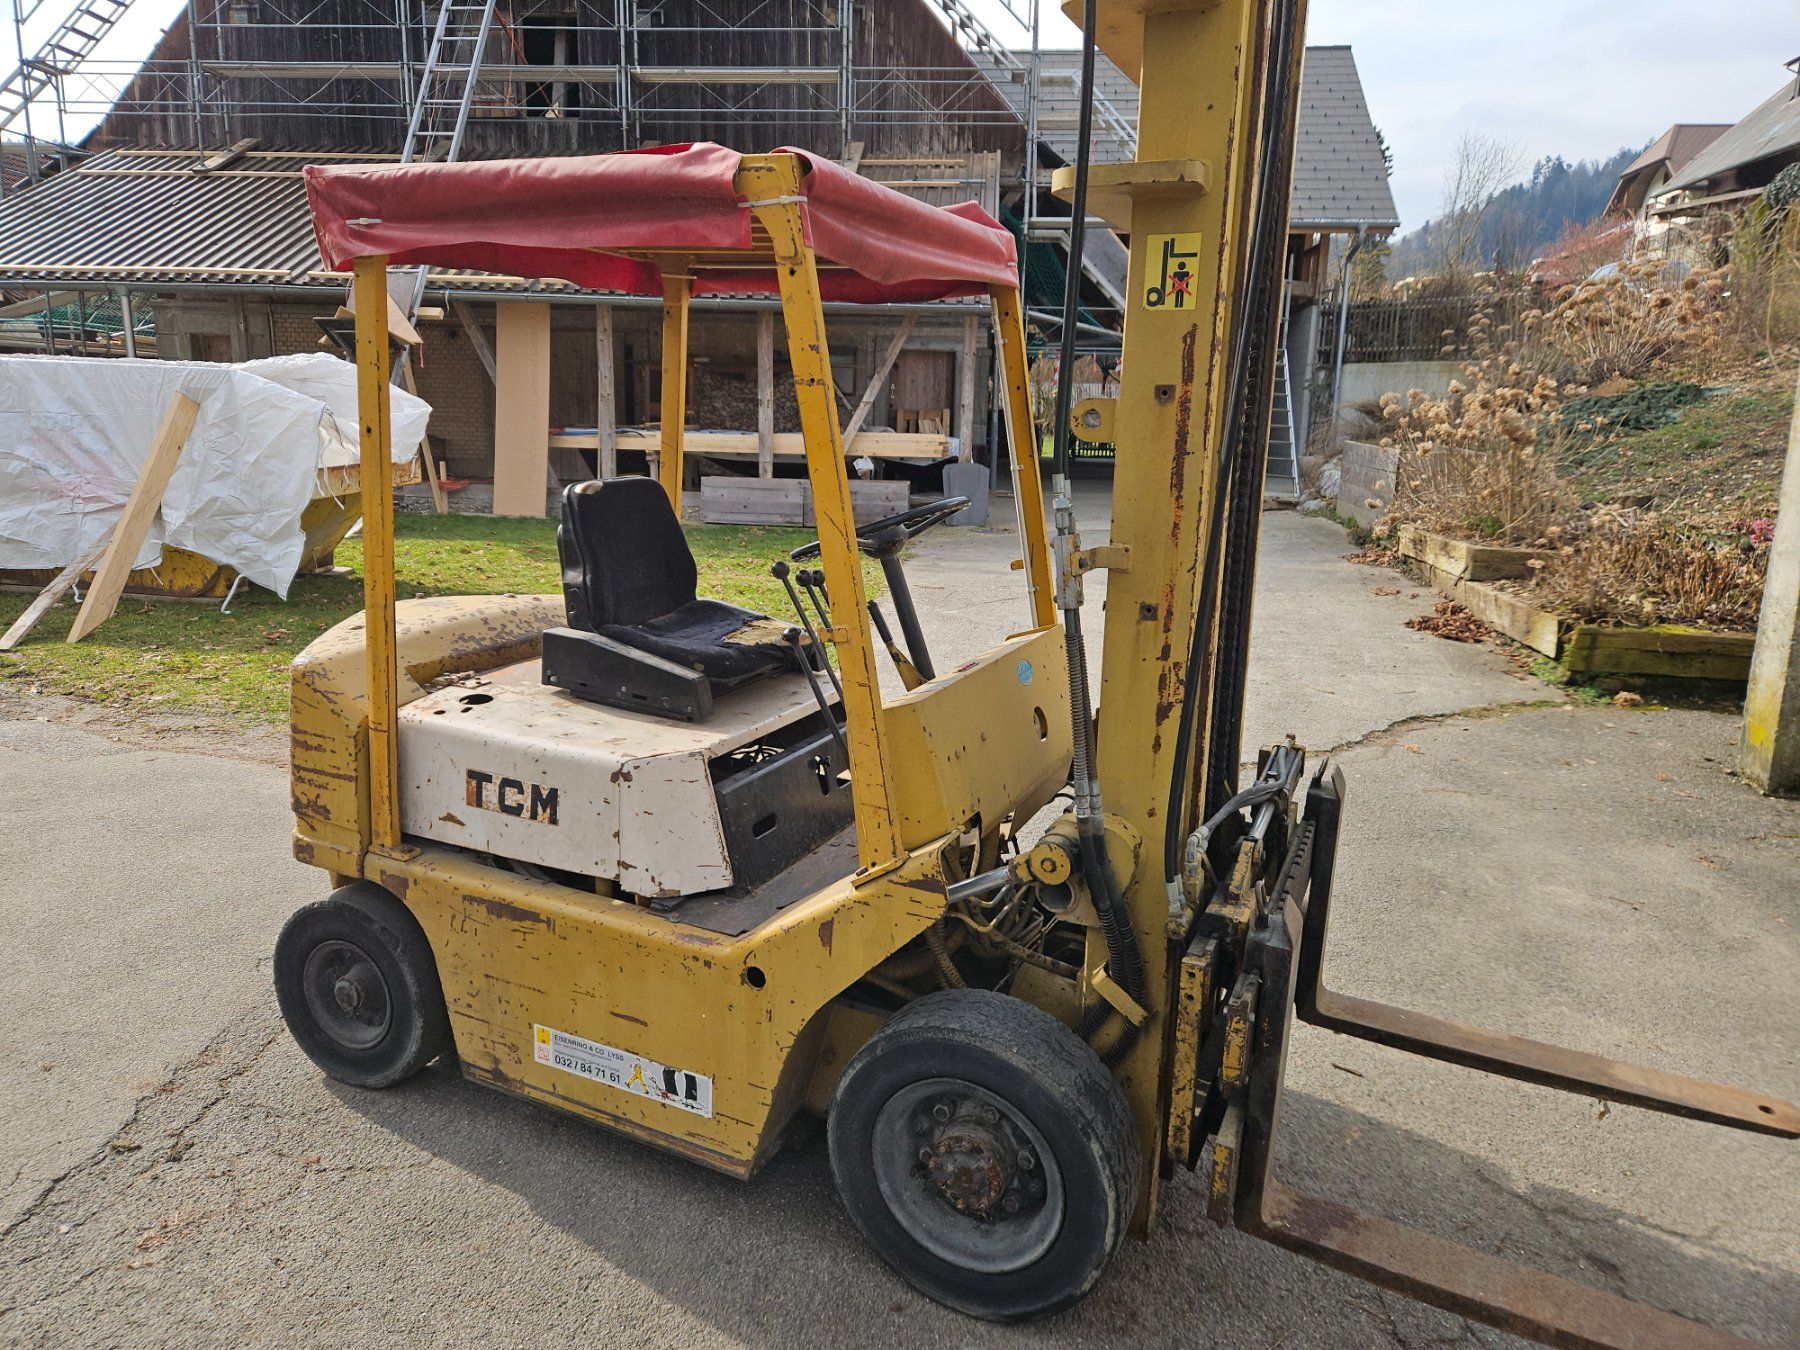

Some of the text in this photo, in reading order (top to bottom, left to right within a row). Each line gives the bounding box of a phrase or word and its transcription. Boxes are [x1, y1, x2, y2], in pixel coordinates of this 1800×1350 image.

[467, 769, 559, 825] TCM
[554, 1034, 588, 1050] EISENRING
[607, 1053, 624, 1061] LYSS
[554, 1055, 572, 1068] 032
[580, 1063, 592, 1074] 84
[595, 1067, 606, 1078] 71
[609, 1072, 620, 1083] 61
